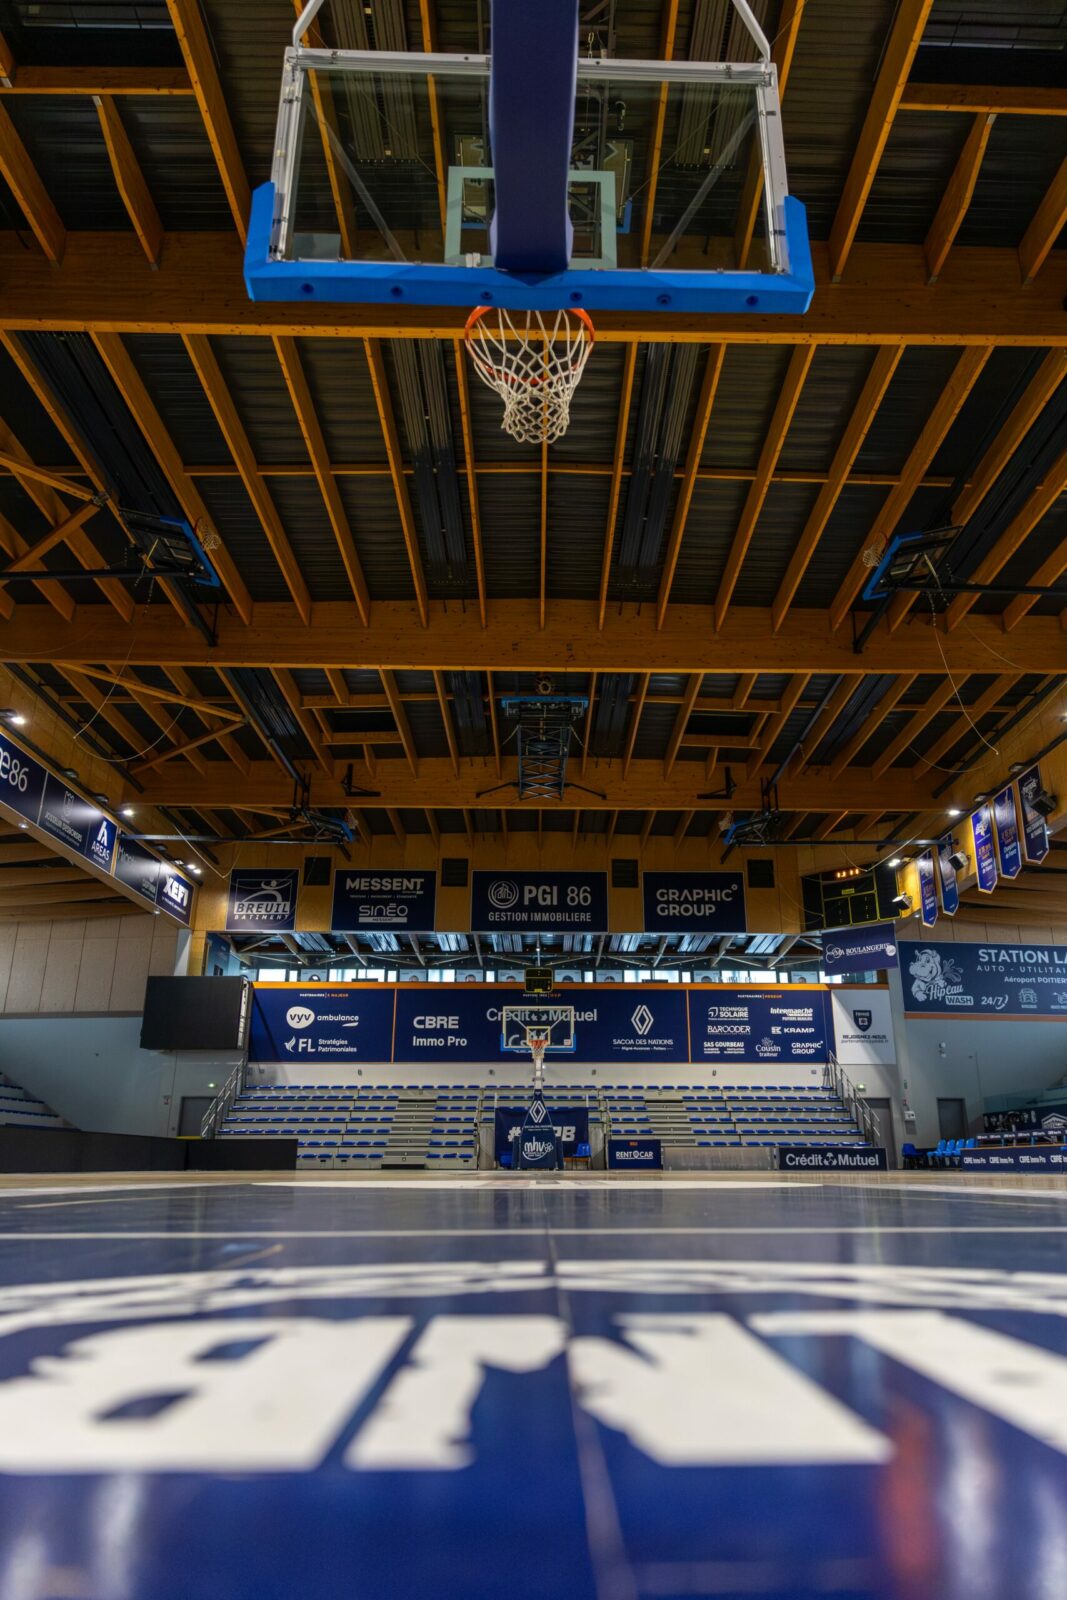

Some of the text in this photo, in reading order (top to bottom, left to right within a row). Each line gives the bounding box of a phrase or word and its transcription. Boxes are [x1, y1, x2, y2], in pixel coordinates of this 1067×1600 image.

[91, 841, 110, 861] AREAS
[346, 878, 424, 891] MESSENT
[523, 886, 592, 906] PGI 86
[656, 889, 733, 902] GRAPHIC
[236, 902, 290, 914] BREUIL
[656, 903, 716, 917] GROUP
[488, 912, 592, 922] GESTION IMMOBILIERE
[978, 949, 1049, 964] STATION
[976, 965, 1005, 973] AUTO
[981, 996, 1003, 1005] 24/7
[290, 1013, 311, 1023] vyv
[413, 1016, 459, 1029] CBRE
[298, 1038, 316, 1052] FL
[412, 1036, 467, 1047] Immo Pro
[755, 1044, 781, 1052] Cousin
[786, 1152, 879, 1166] Crédit Mutuel
